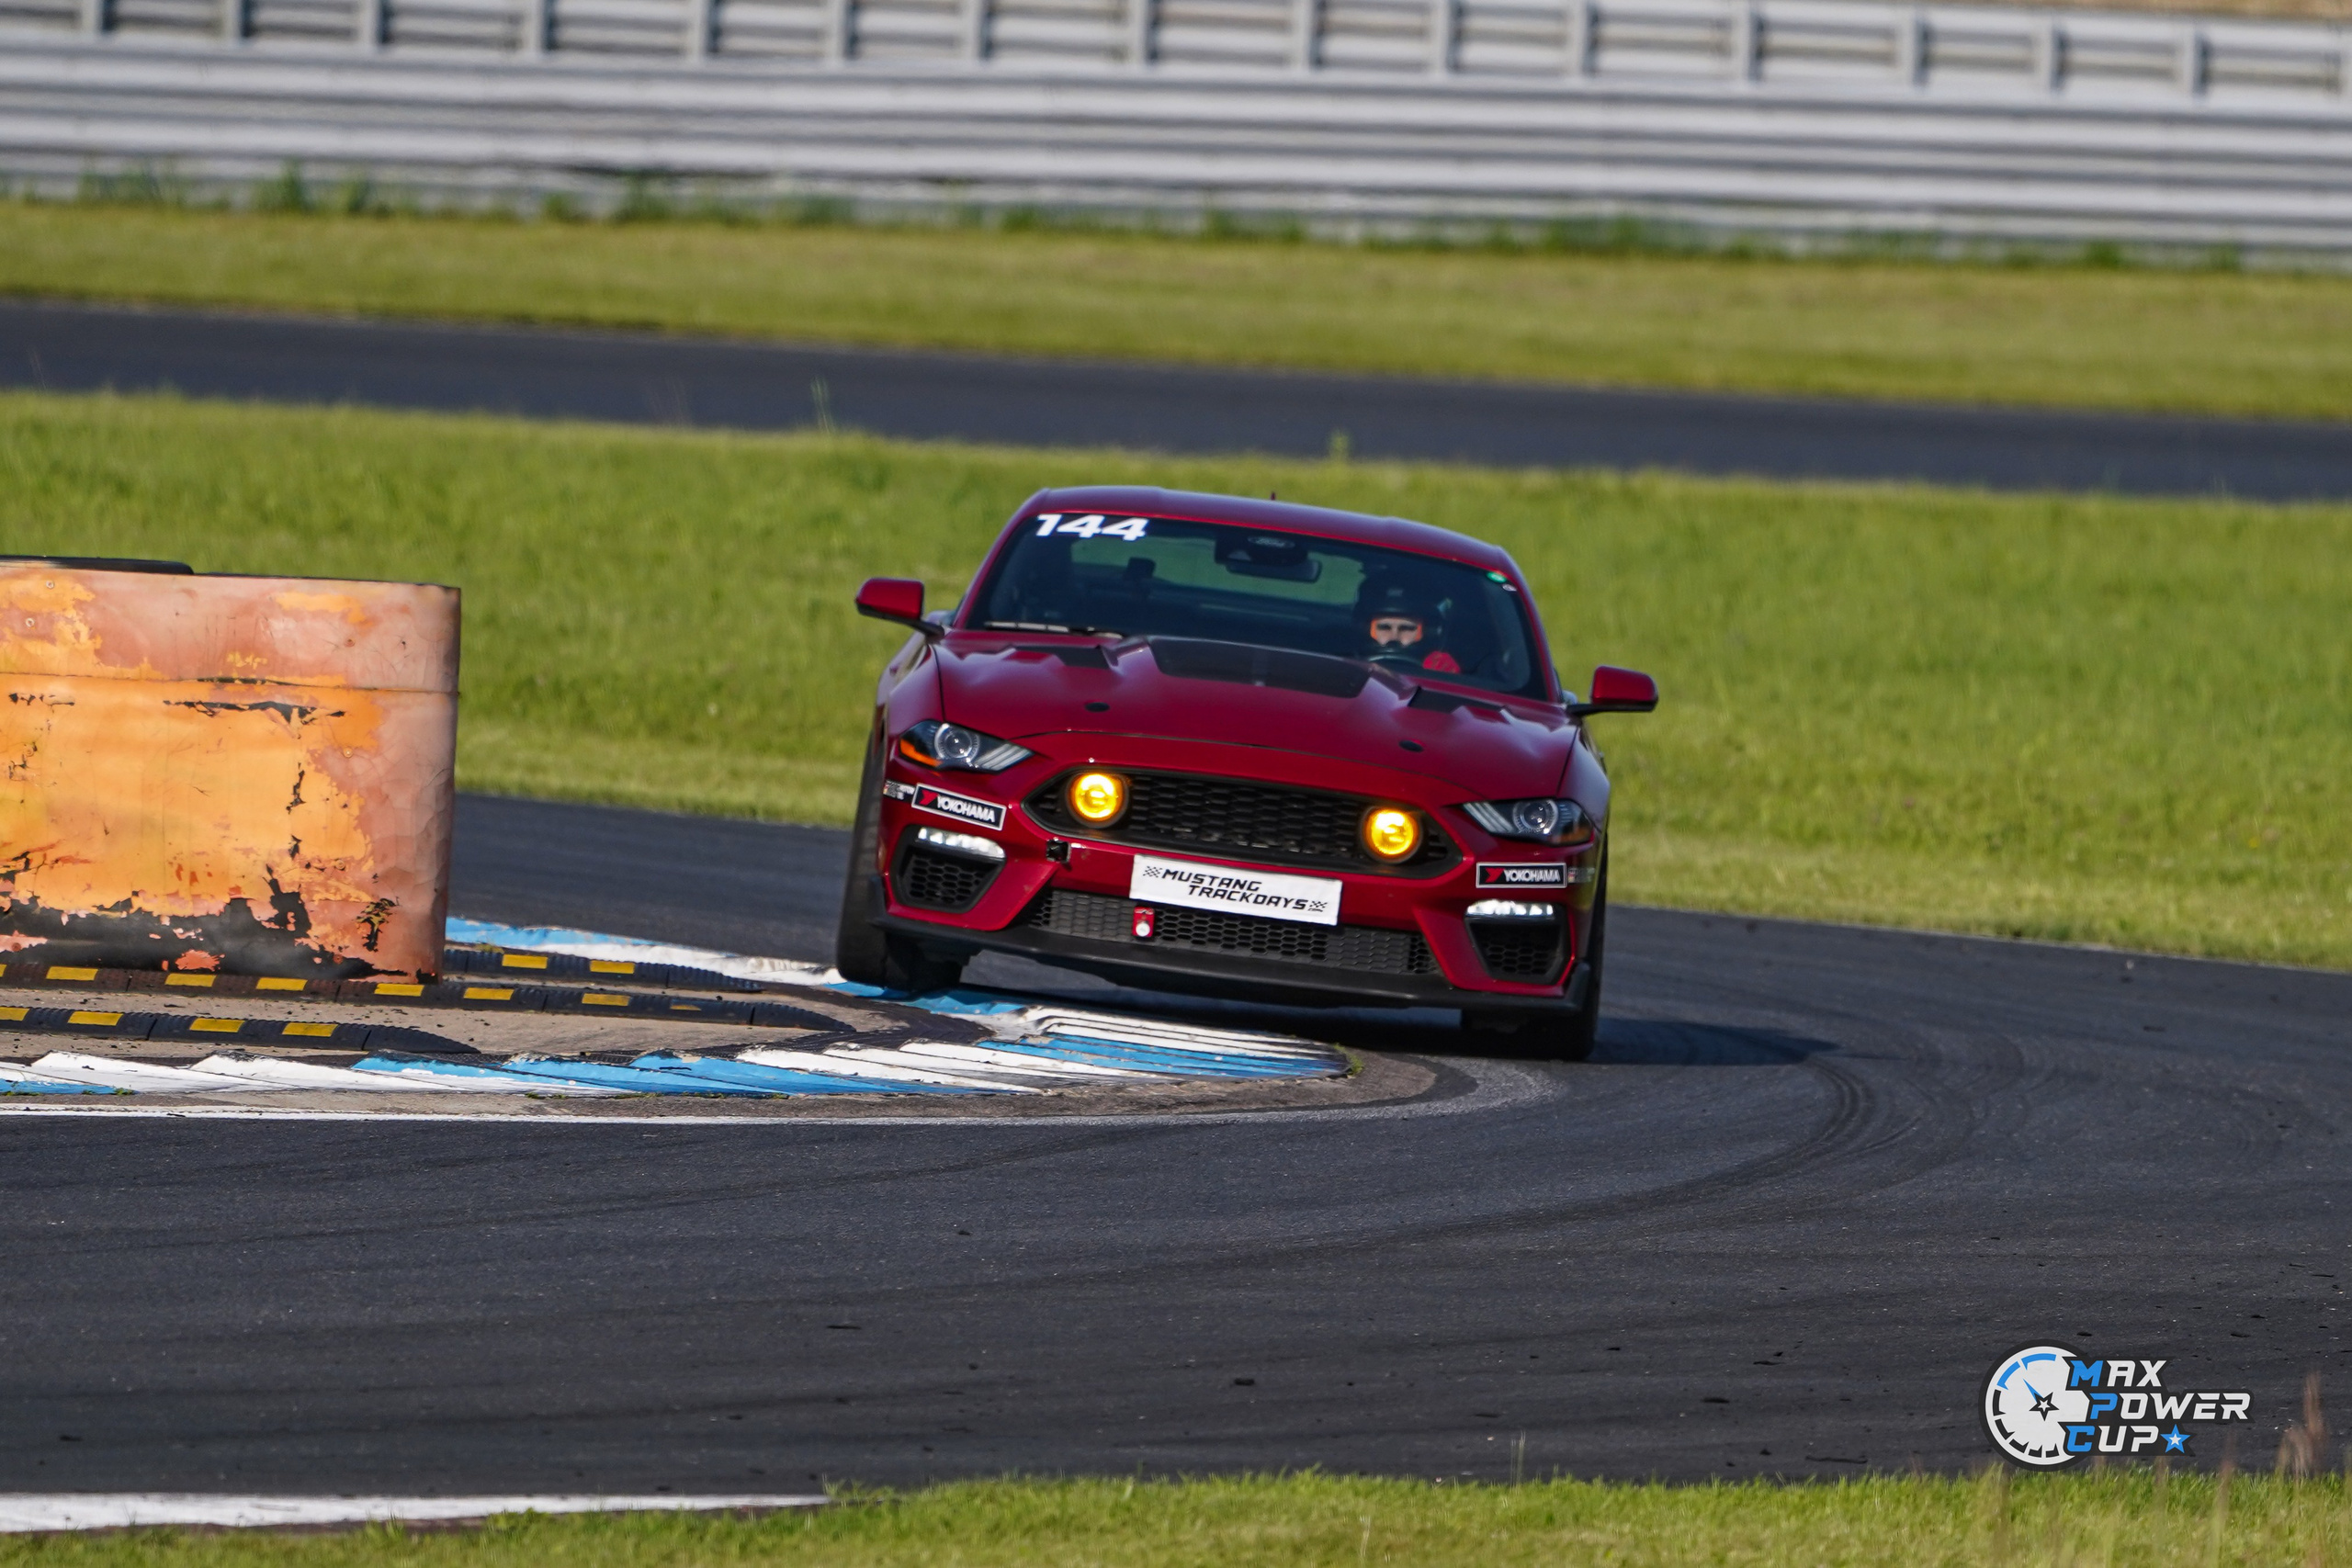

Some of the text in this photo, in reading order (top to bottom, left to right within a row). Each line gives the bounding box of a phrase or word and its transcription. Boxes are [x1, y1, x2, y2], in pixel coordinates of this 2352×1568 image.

[1035, 514, 1148, 541] 144
[937, 795, 996, 823] YOKOHAMA
[1162, 868, 1262, 892] MUSTANG
[1503, 869, 1561, 882] YOKOHAMA
[1188, 885, 1308, 909] TRACKDAYS
